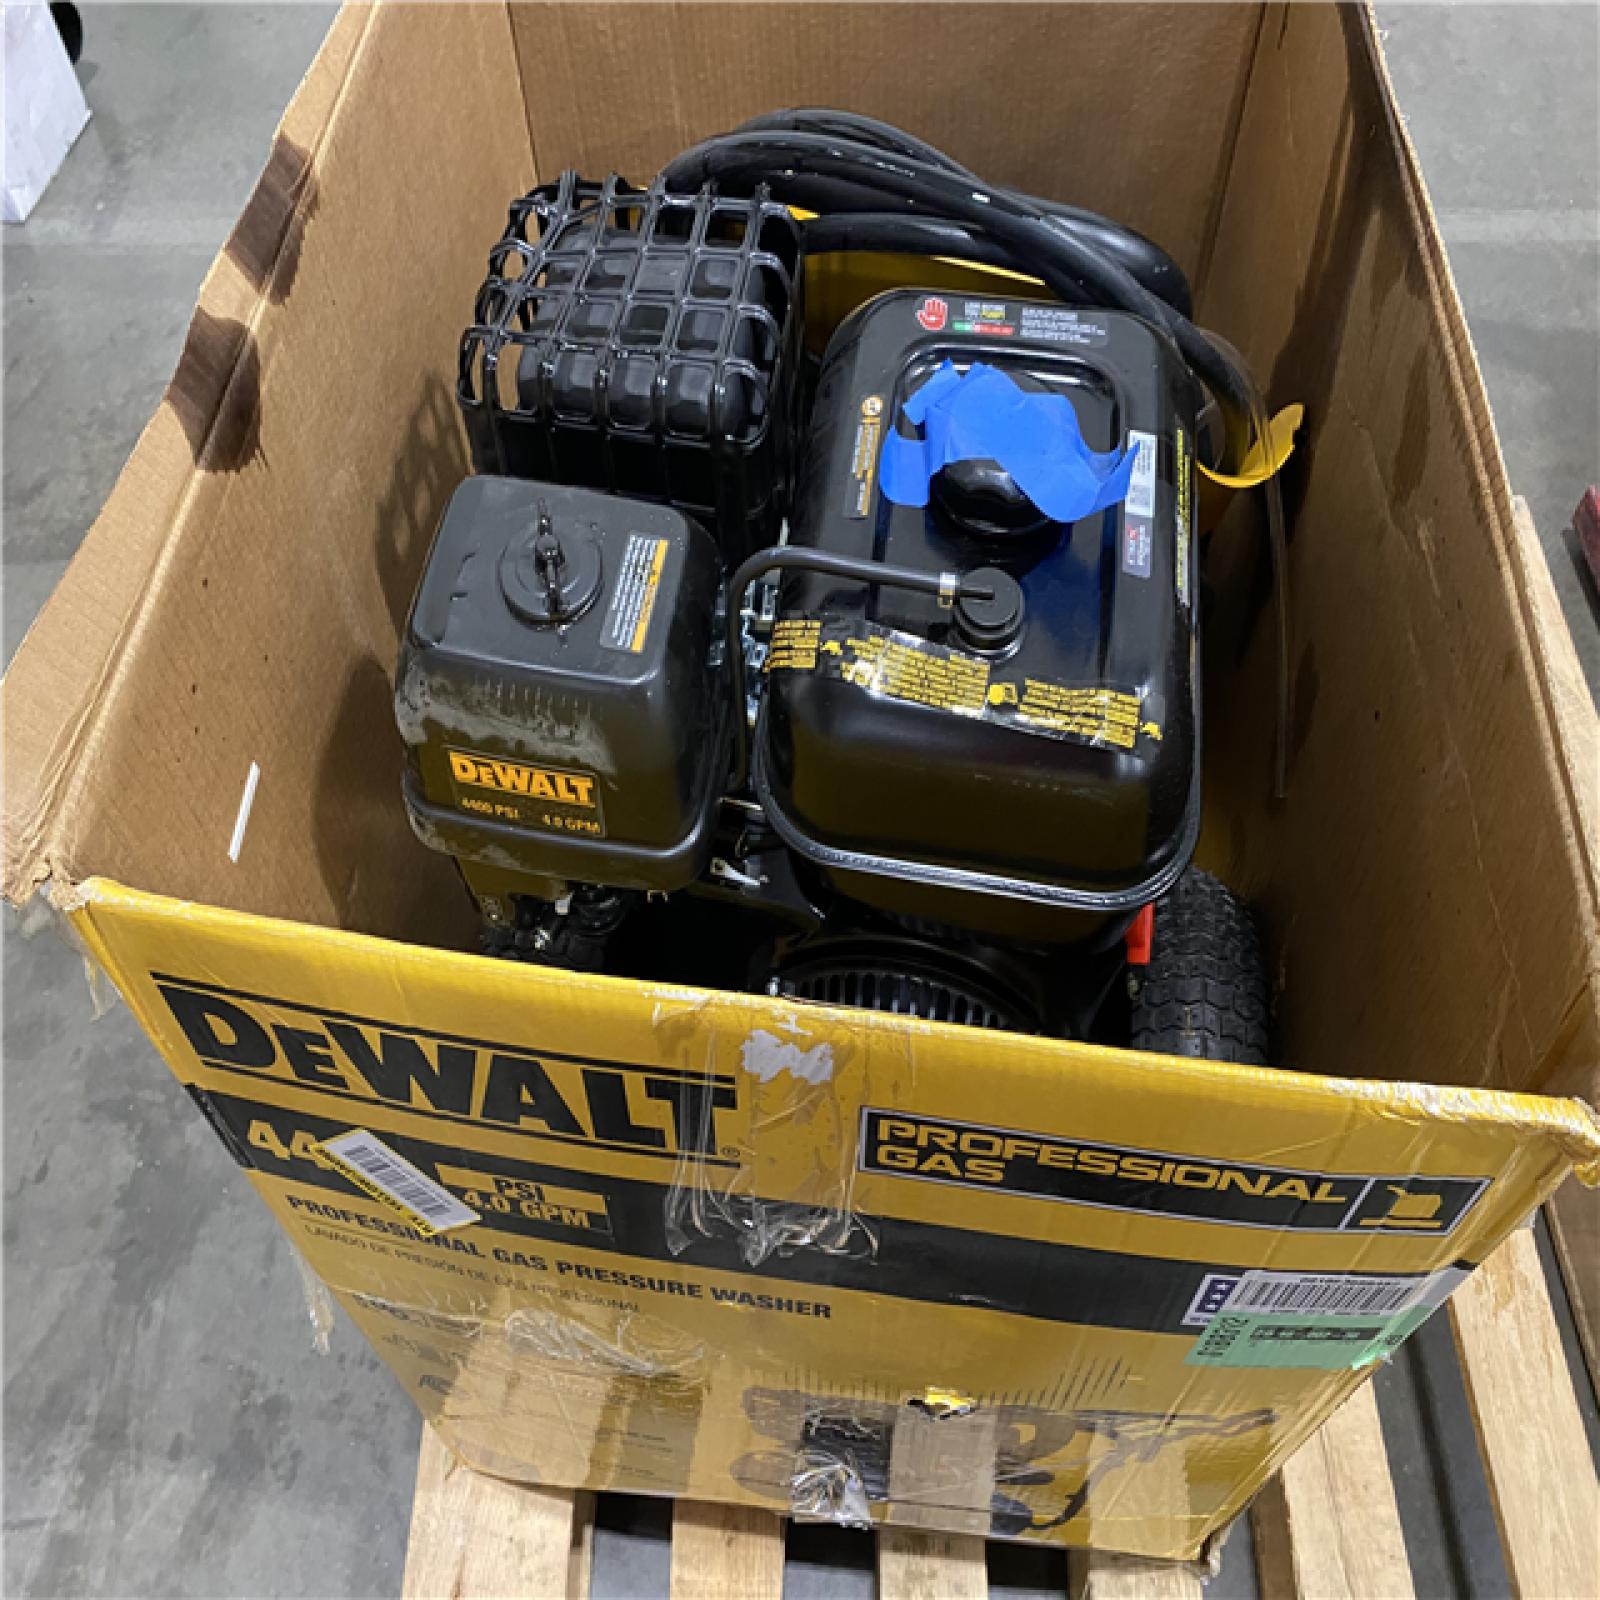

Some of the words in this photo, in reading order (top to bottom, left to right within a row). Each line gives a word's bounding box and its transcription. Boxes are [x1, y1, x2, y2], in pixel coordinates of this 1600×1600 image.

[450, 753, 594, 804] DEWALT
[157, 985, 737, 1156] DEWALT
[877, 1144, 1005, 1181] GAS
[878, 1118, 1346, 1203] PROFESSIONAL
[464, 1190, 511, 1214] 4.0
[520, 1201, 590, 1229] GPM
[495, 1179, 543, 1202] PSI
[492, 1247, 548, 1272] GAS
[555, 1259, 704, 1299] PRESSURE
[709, 1286, 833, 1320] WASHER
